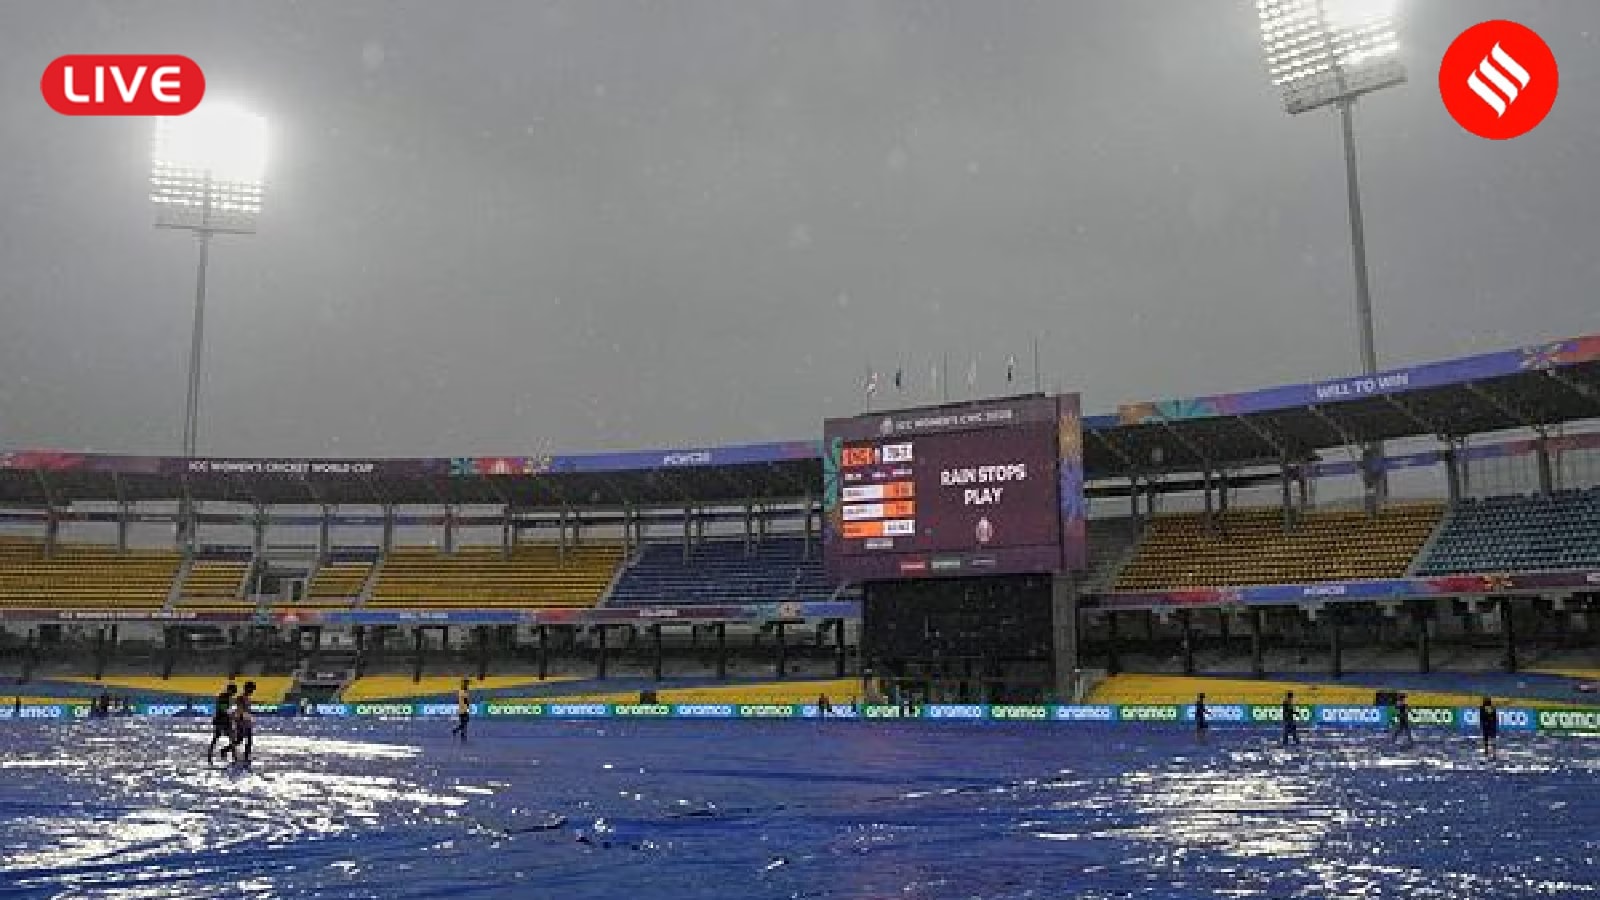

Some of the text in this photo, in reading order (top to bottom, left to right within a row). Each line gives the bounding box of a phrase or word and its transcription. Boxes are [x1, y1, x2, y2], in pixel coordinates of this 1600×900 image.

[1316, 384, 1349, 398] WILL
[1355, 377, 1374, 393] TO
[940, 463, 1027, 486] RAIN STOPS
[964, 486, 1004, 505] PLAY
[356, 704, 413, 716] aramco
[487, 704, 542, 716] aramco
[551, 704, 606, 716] aramco
[615, 704, 670, 716] aramco
[679, 704, 732, 717] aramco
[740, 704, 793, 716] aramco
[930, 705, 982, 718] aramco
[991, 705, 1046, 718] aramco
[1058, 705, 1112, 719] aramco
[1120, 705, 1177, 720] aramco
[1322, 707, 1380, 722] aramco
